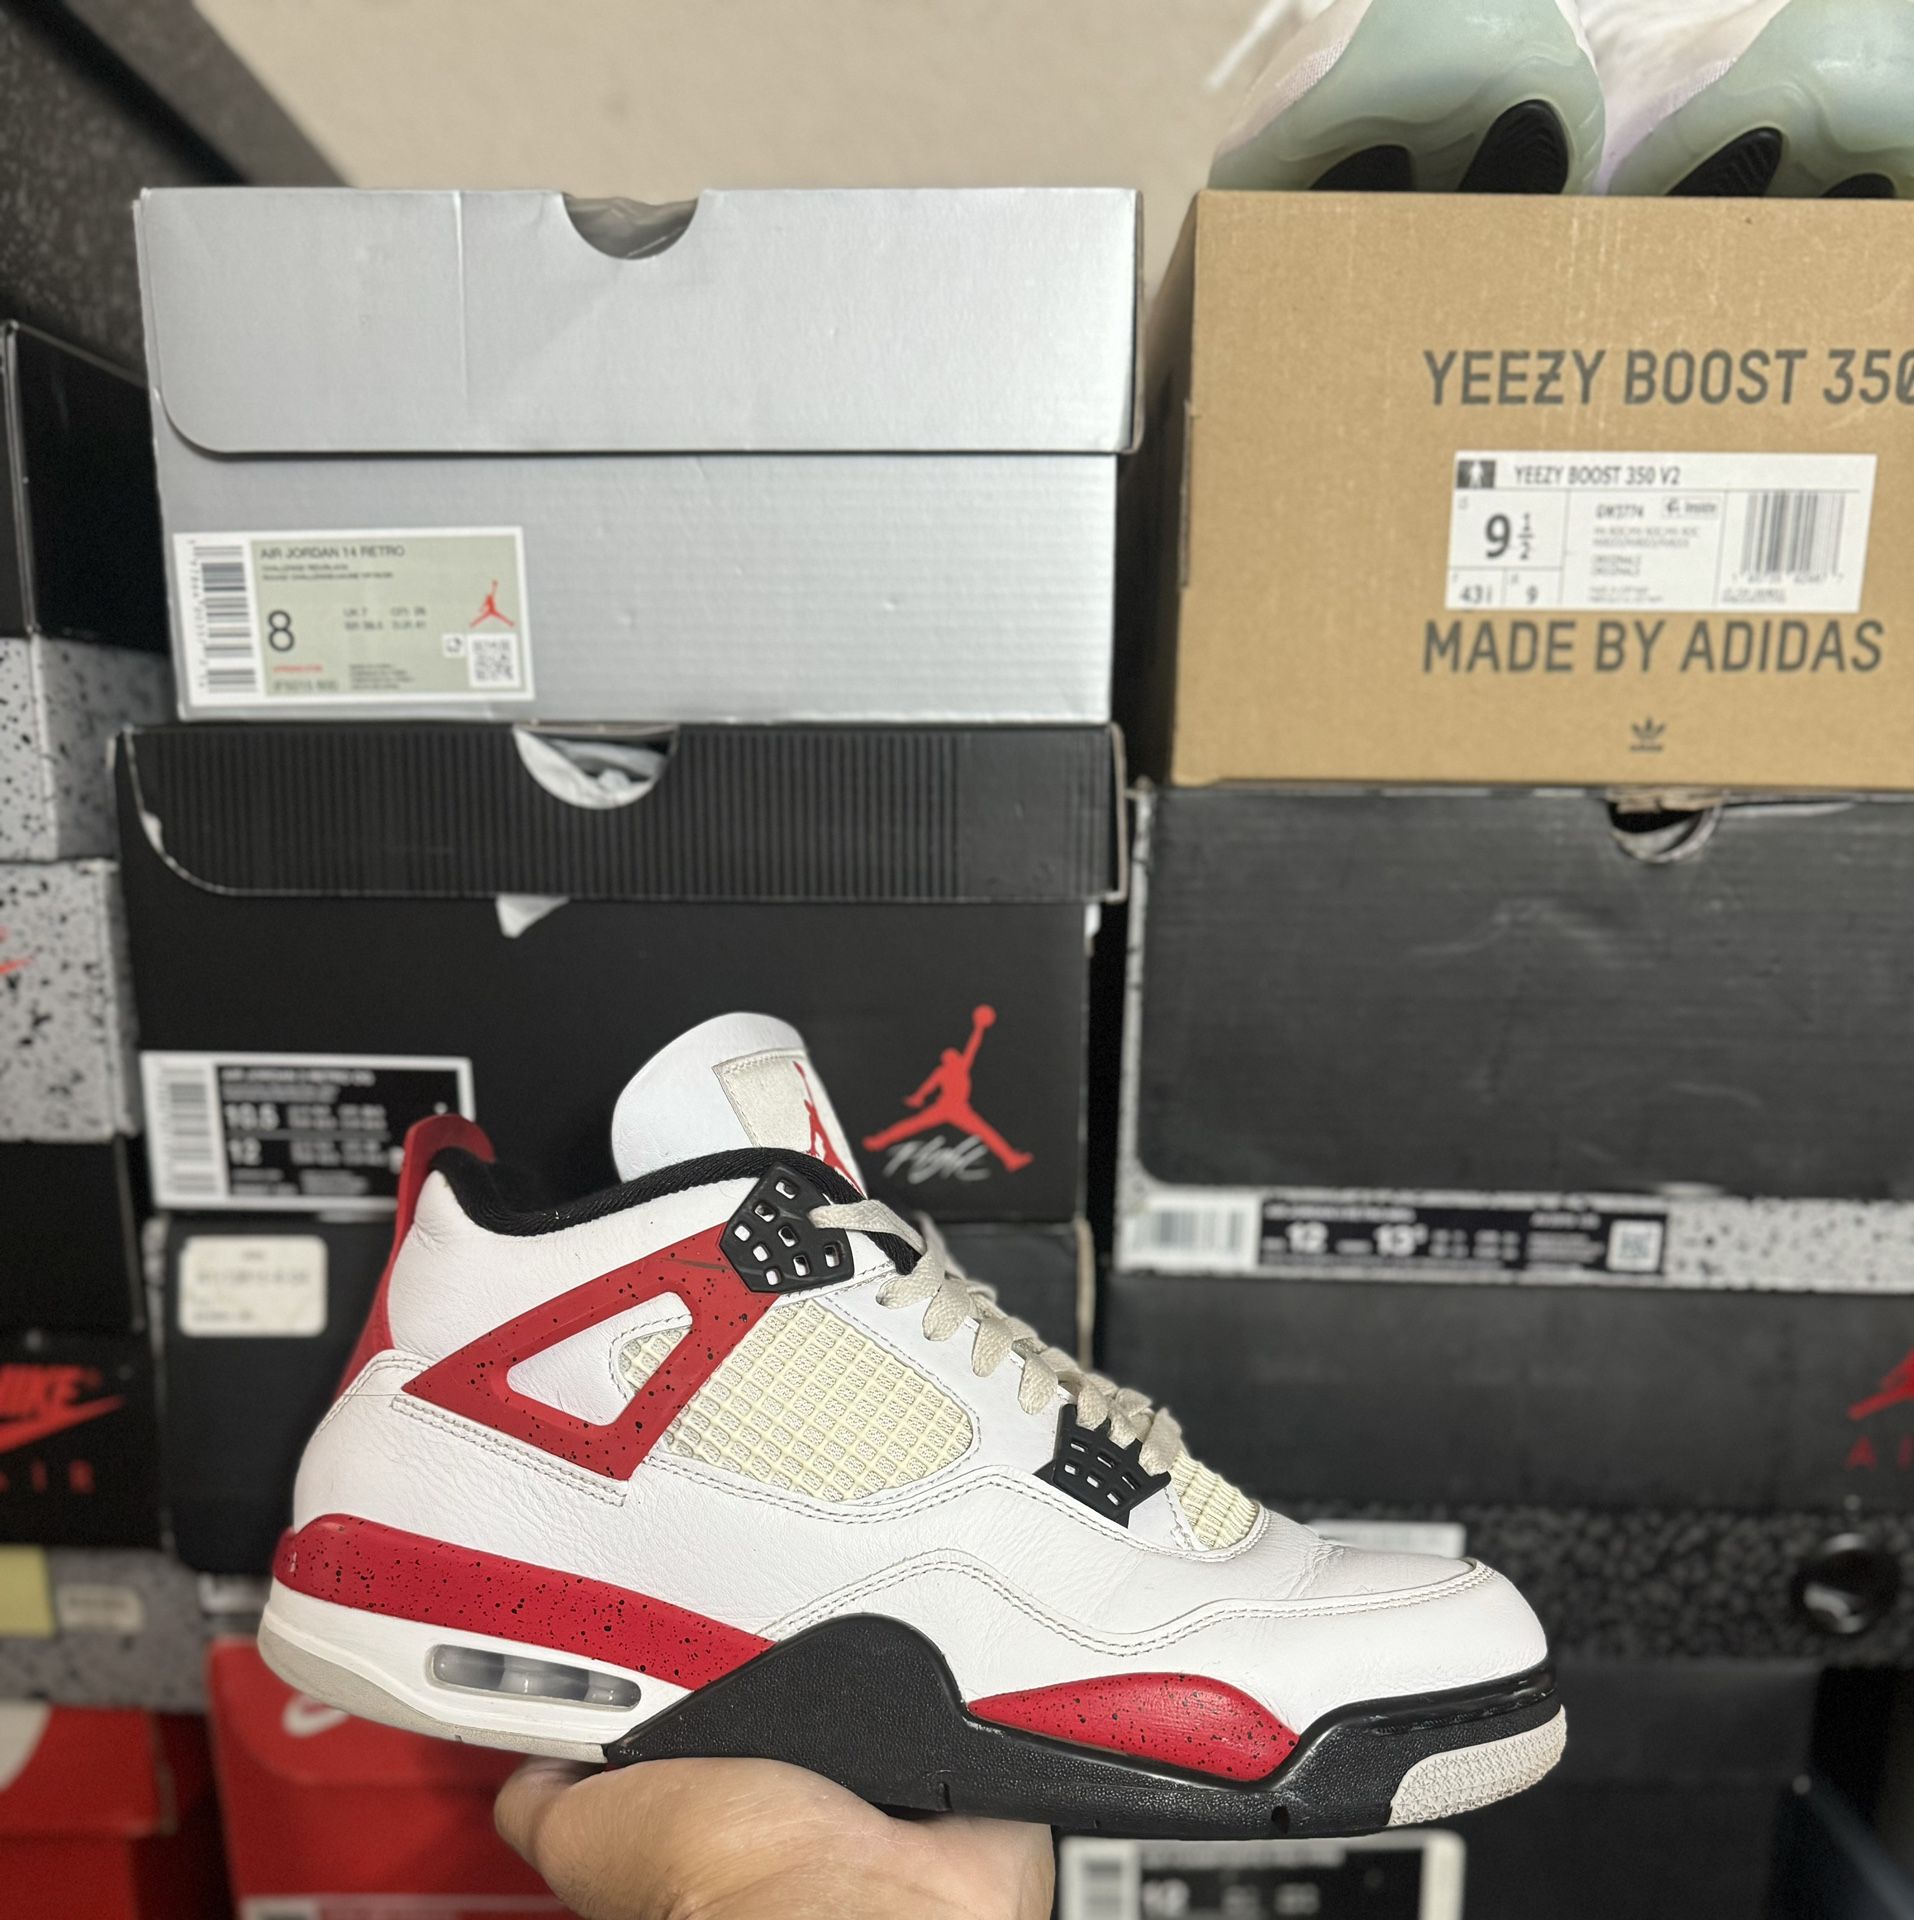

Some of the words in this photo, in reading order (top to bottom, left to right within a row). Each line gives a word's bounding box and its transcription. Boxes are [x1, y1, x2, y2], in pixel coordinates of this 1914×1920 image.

[1423, 349, 1606, 406] YEEZY
[1624, 349, 1807, 406] BOOST
[1514, 465, 1564, 486] YEEZY
[1568, 465, 1622, 486] BOOST
[1625, 465, 1656, 486] 350
[1660, 465, 1681, 486] V2
[260, 546, 283, 559] AIR
[286, 546, 340, 559] JORDAN
[360, 544, 406, 558] RETRO
[268, 609, 295, 653] 8
[1423, 619, 1577, 674] MADE
[1595, 619, 1666, 674] BY
[1680, 619, 1886, 674] ADIDAS
